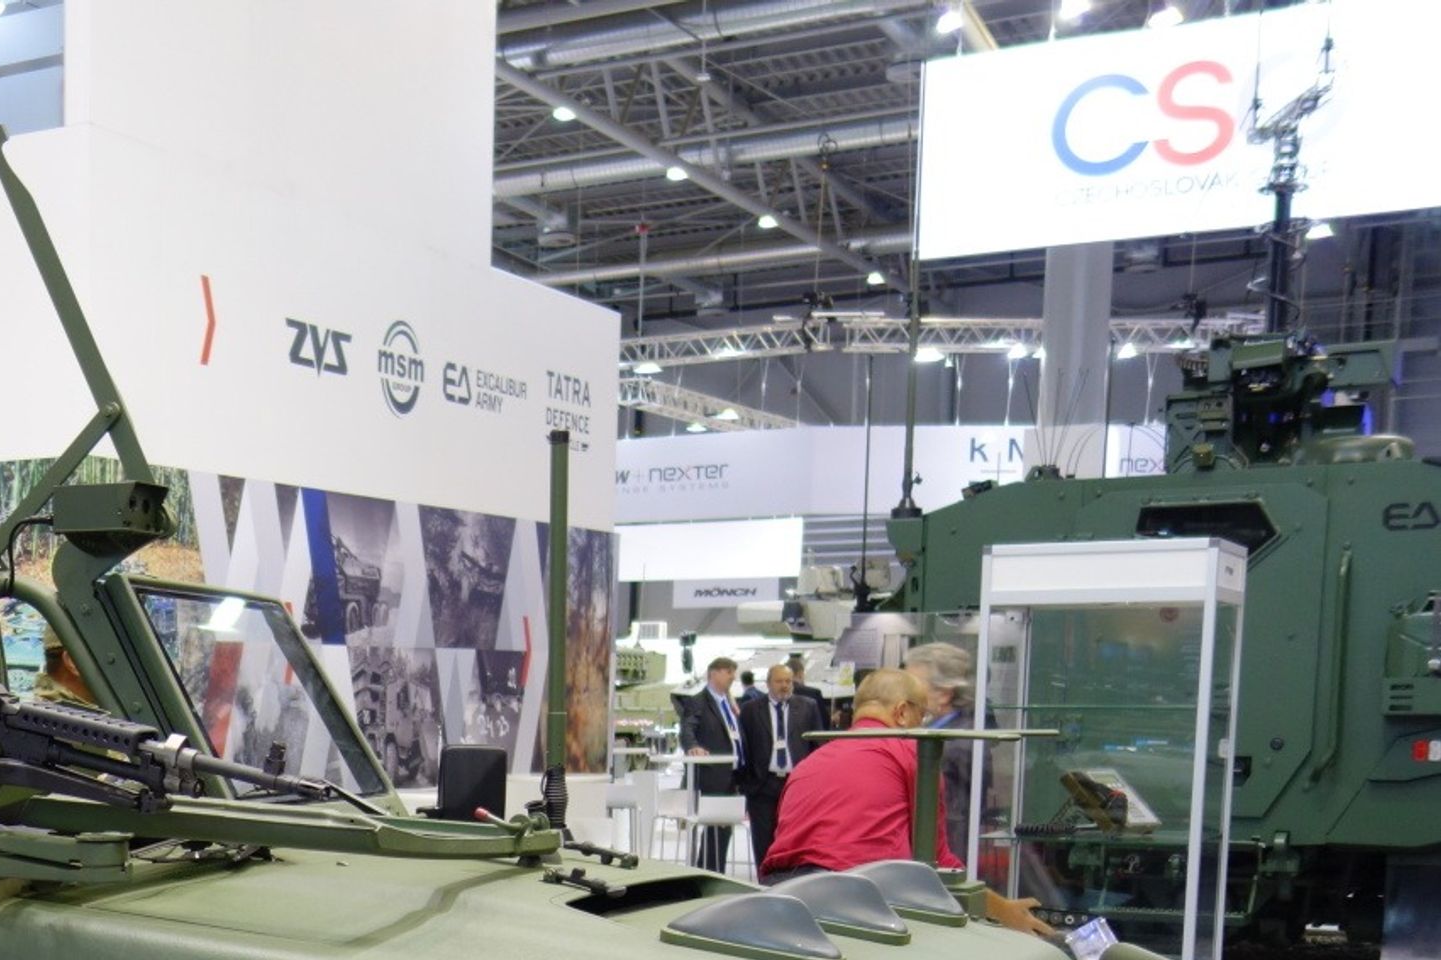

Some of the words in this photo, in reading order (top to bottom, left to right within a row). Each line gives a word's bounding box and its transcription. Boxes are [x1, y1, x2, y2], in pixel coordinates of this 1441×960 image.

[285, 317, 352, 377] ZVS
[377, 349, 425, 382] msm
[476, 370, 527, 400] EXCALIBUR
[546, 370, 591, 408] TATRA
[475, 394, 504, 414] ARMY
[546, 407, 590, 434] DEFENCE
